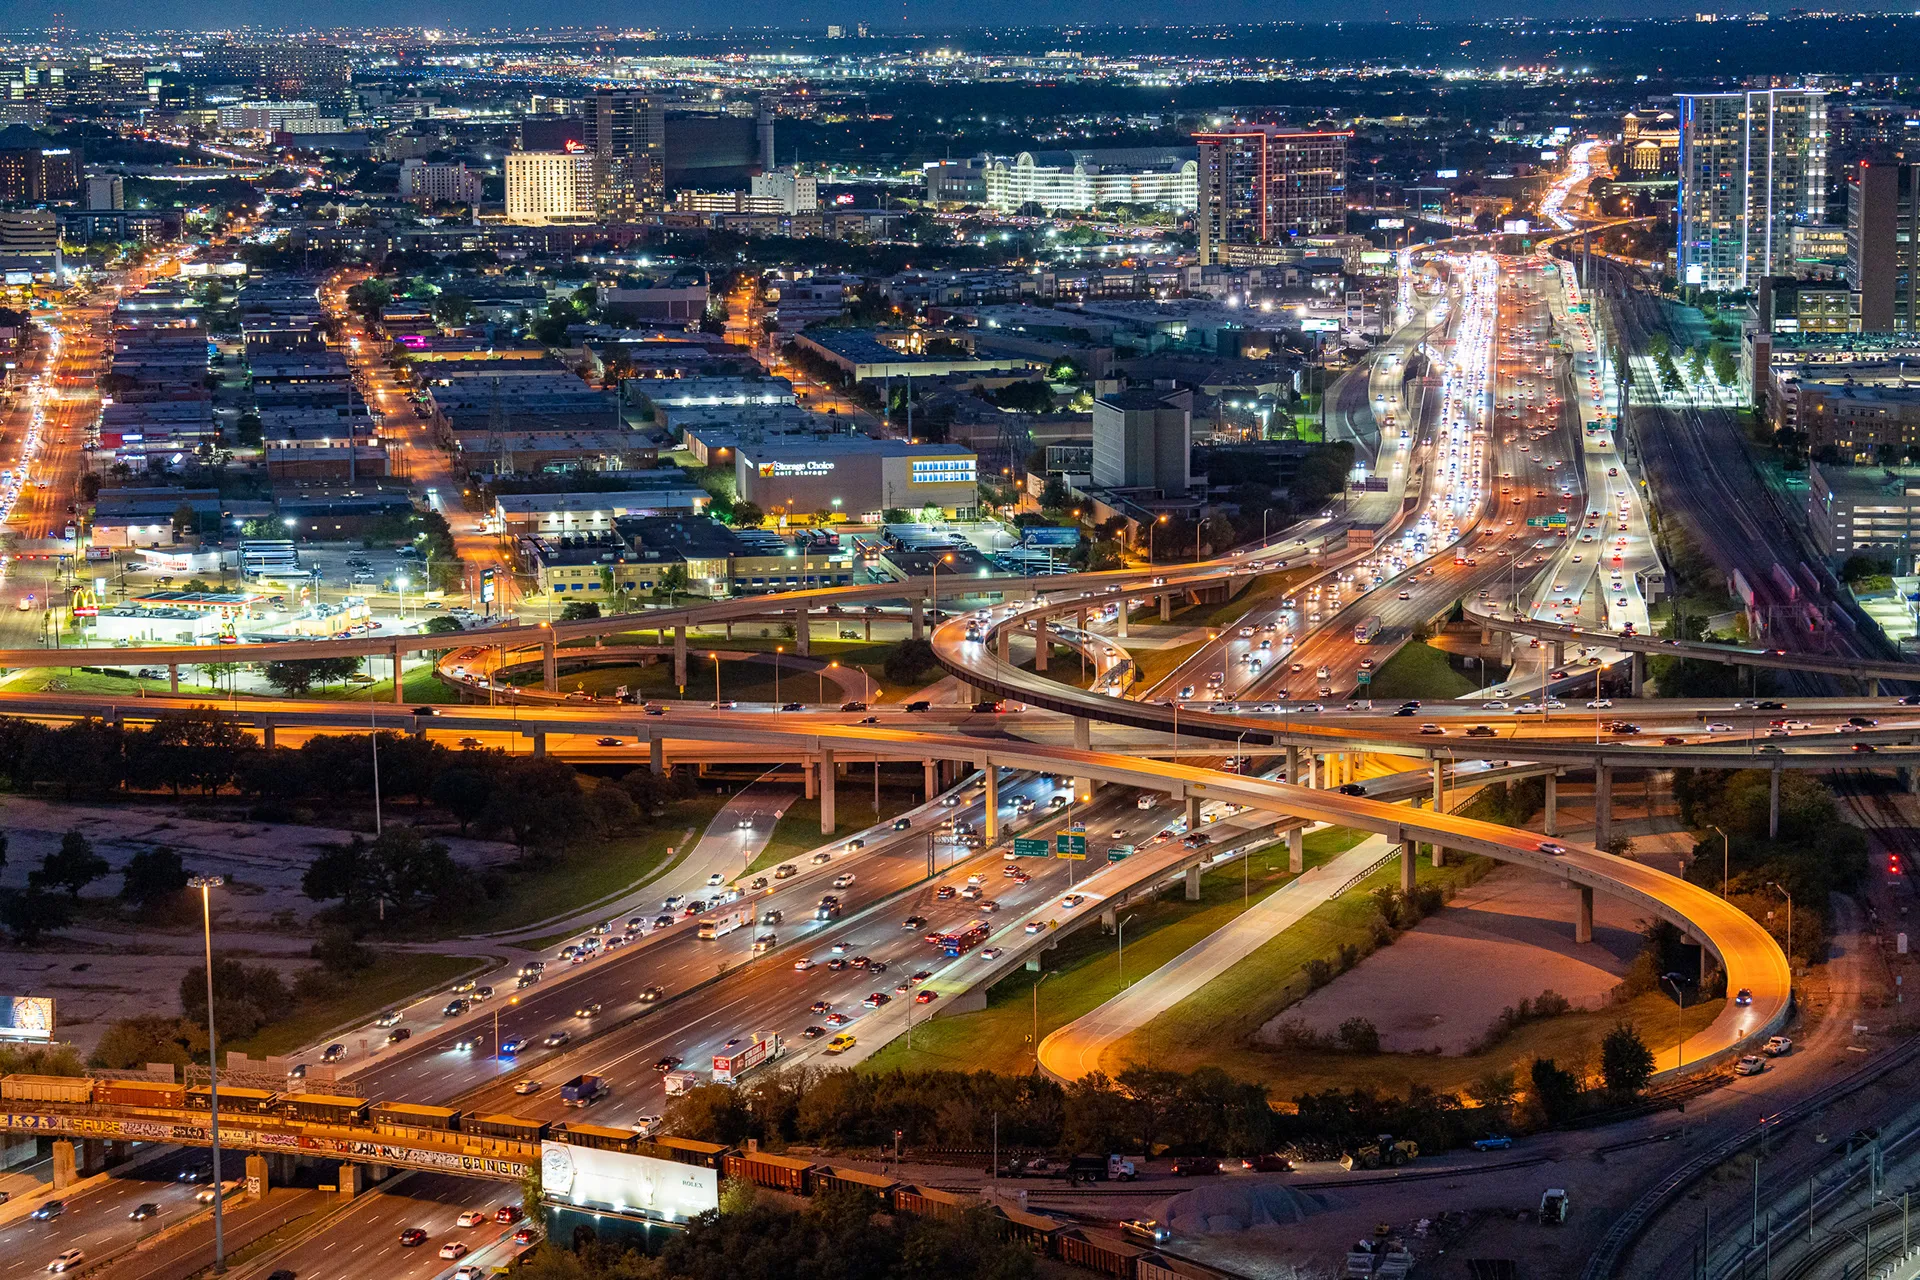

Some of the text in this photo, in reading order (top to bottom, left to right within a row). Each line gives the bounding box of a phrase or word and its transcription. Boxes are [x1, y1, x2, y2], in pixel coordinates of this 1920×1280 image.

[775, 461, 835, 471] Storage Choice
[73, 1118, 120, 1133] SAUCE
[682, 1180, 703, 1188] ROLEX
